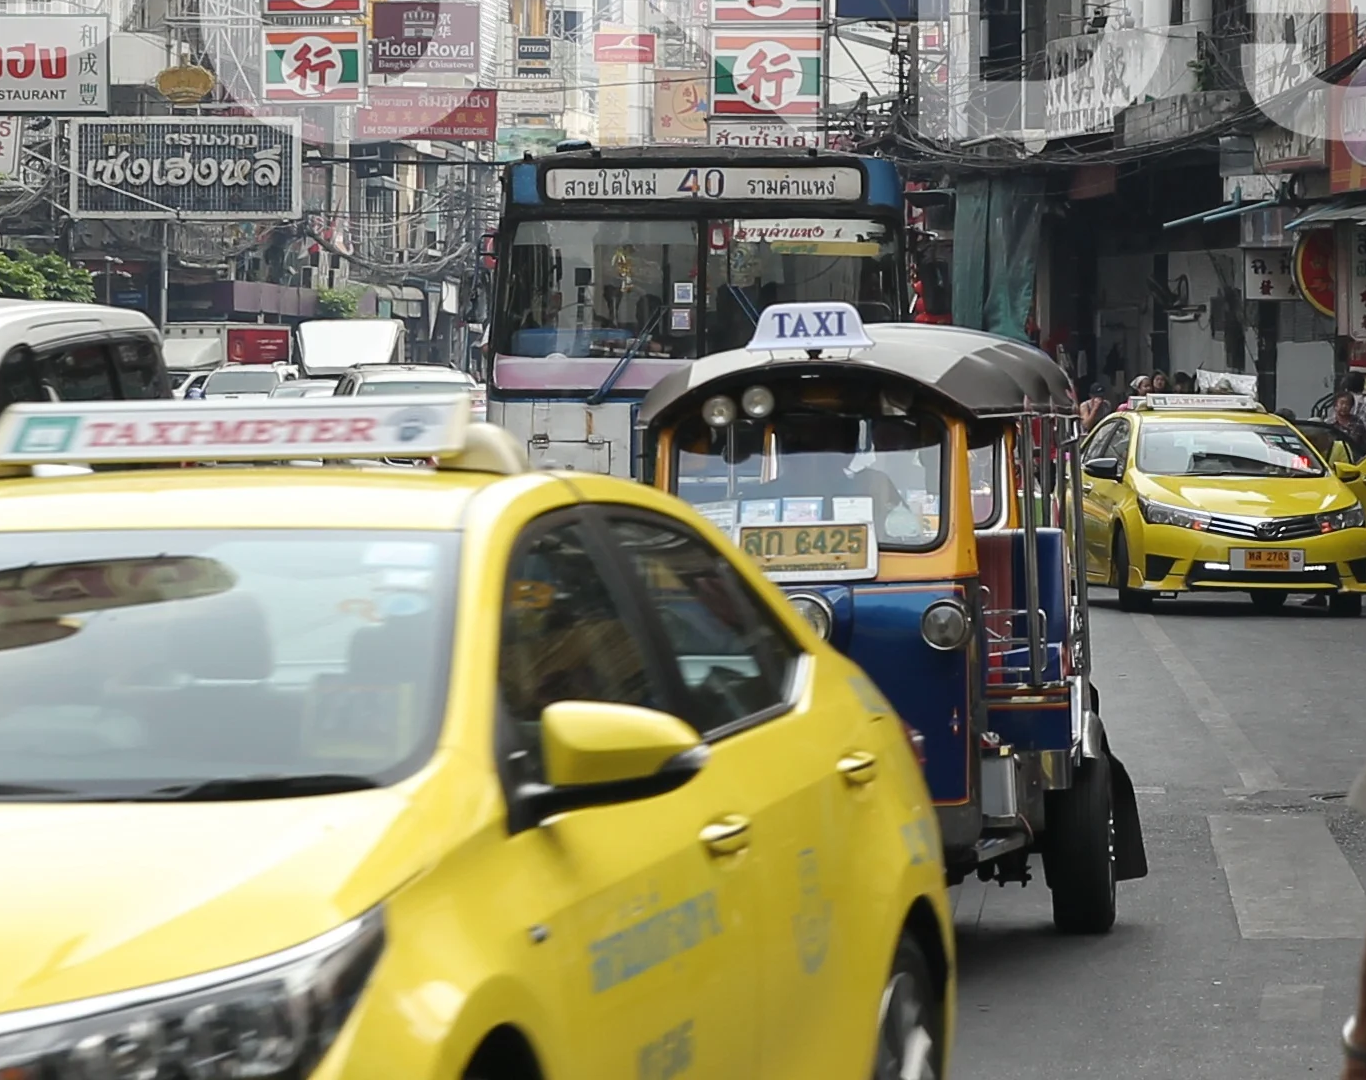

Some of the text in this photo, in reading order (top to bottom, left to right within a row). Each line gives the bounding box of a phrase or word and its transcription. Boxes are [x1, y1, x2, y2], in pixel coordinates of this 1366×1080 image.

[378, 41, 475, 58] Hotel Royal
[519, 45, 550, 53] CITIZEN
[378, 60, 416, 70] Bangkok
[428, 60, 475, 69] Chinatown
[363, 125, 376, 135] LIM
[377, 125, 397, 135] SOON
[420, 126, 453, 136] NATURAL
[454, 126, 489, 136] MEDICINE
[564, 167, 837, 199] สายใต้ใหม่ 40 รามคำแหง
[772, 310, 847, 339] TAXI
[85, 416, 379, 449] TAXI-METER
[795, 529, 863, 555] 6425
